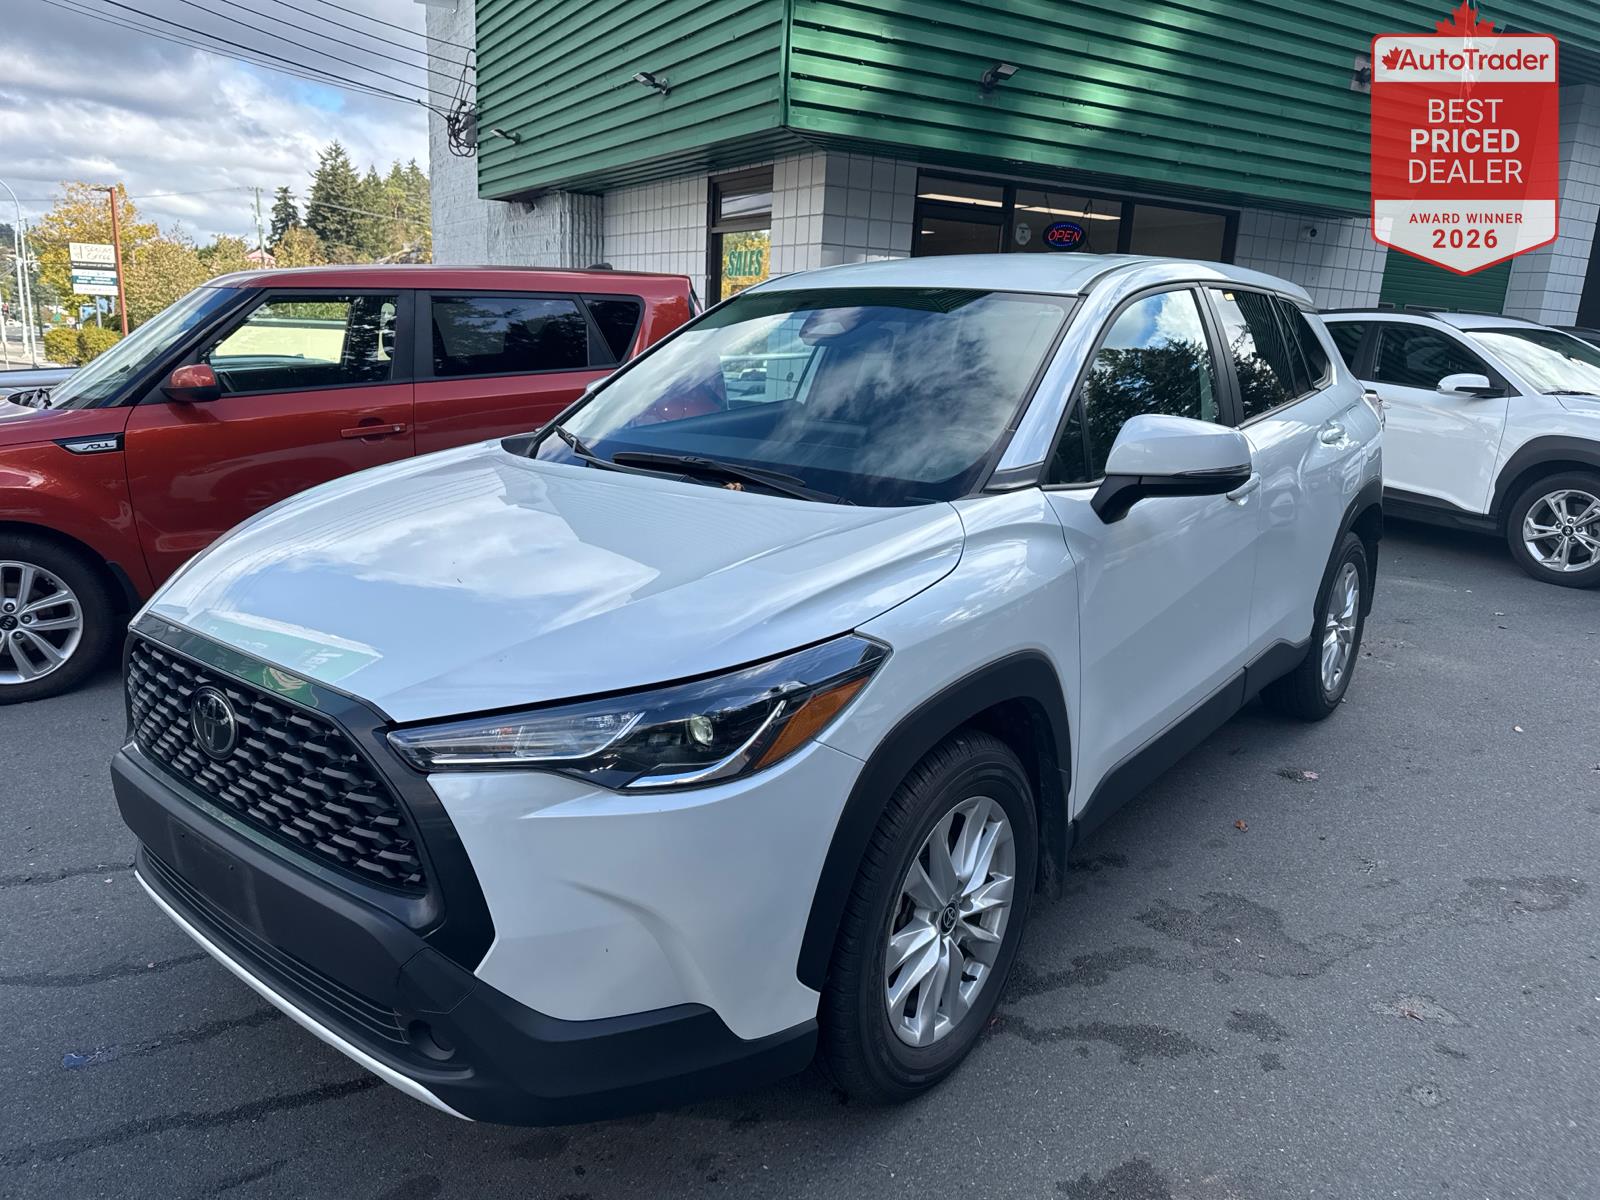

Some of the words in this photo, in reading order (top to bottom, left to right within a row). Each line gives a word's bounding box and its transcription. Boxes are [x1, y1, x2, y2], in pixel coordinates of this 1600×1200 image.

[1048, 228, 1082, 242] OPEN
[728, 250, 763, 276] SALES
[82, 442, 114, 450] SOUL
